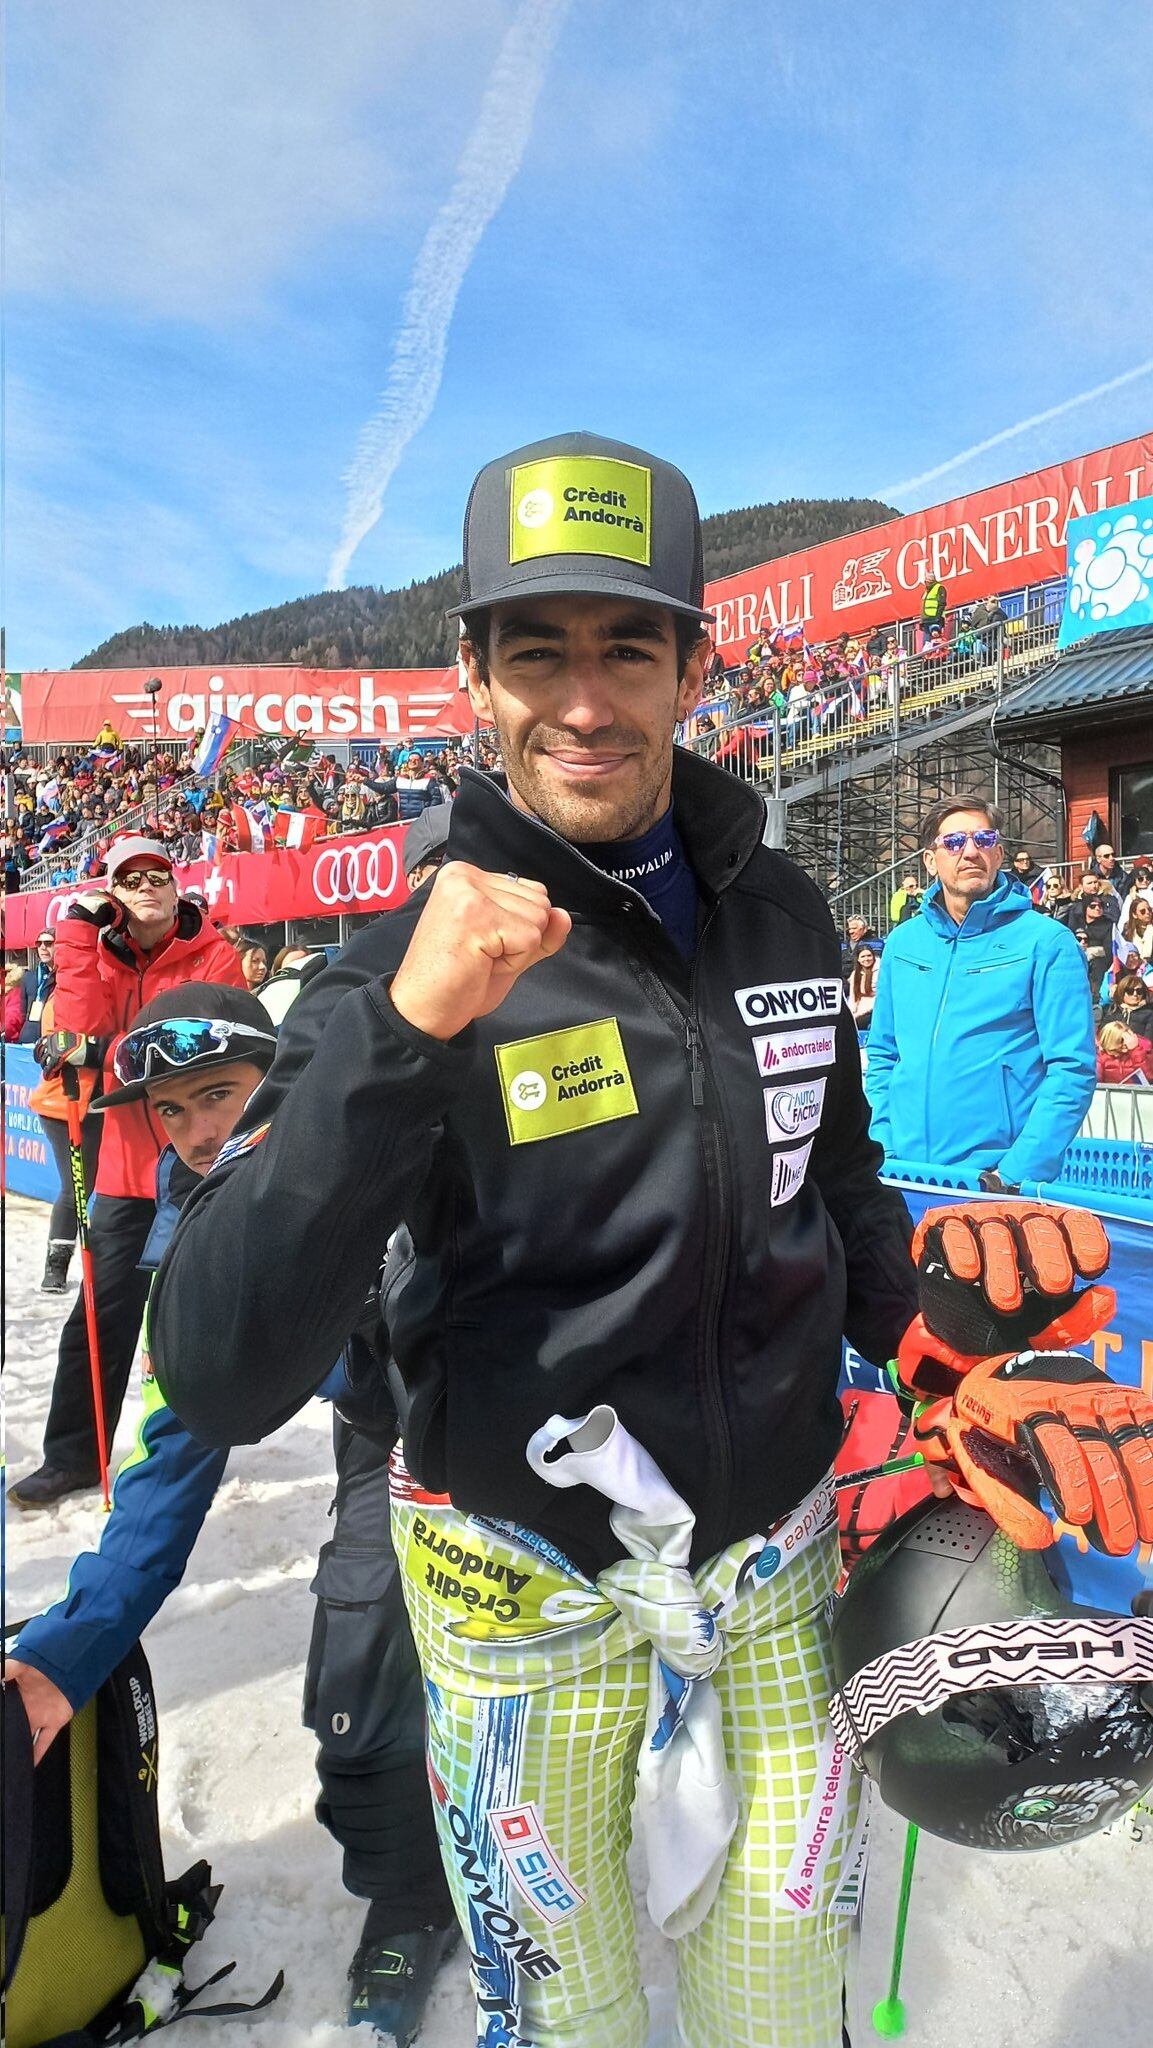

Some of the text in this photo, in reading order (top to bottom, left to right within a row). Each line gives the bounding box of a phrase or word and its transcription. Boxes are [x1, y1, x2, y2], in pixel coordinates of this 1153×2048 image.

[563, 487, 627, 509] Crèdit
[563, 506, 644, 533] Andorrà
[167, 676, 401, 734] aircash
[551, 1055, 603, 1081] Crèdit
[557, 1069, 625, 1102] Andorrà
[794, 1089, 815, 1107] AUTO
[18, 1137, 47, 1165] GORA
[784, 1490, 829, 1551] caldea
[412, 1516, 532, 1595] Andorrà
[424, 1562, 521, 1623] Crèdit
[948, 1640, 1126, 1669] HEAD
[141, 1692, 155, 1740] REBELS
[801, 1739, 845, 1878] andorra teleco
